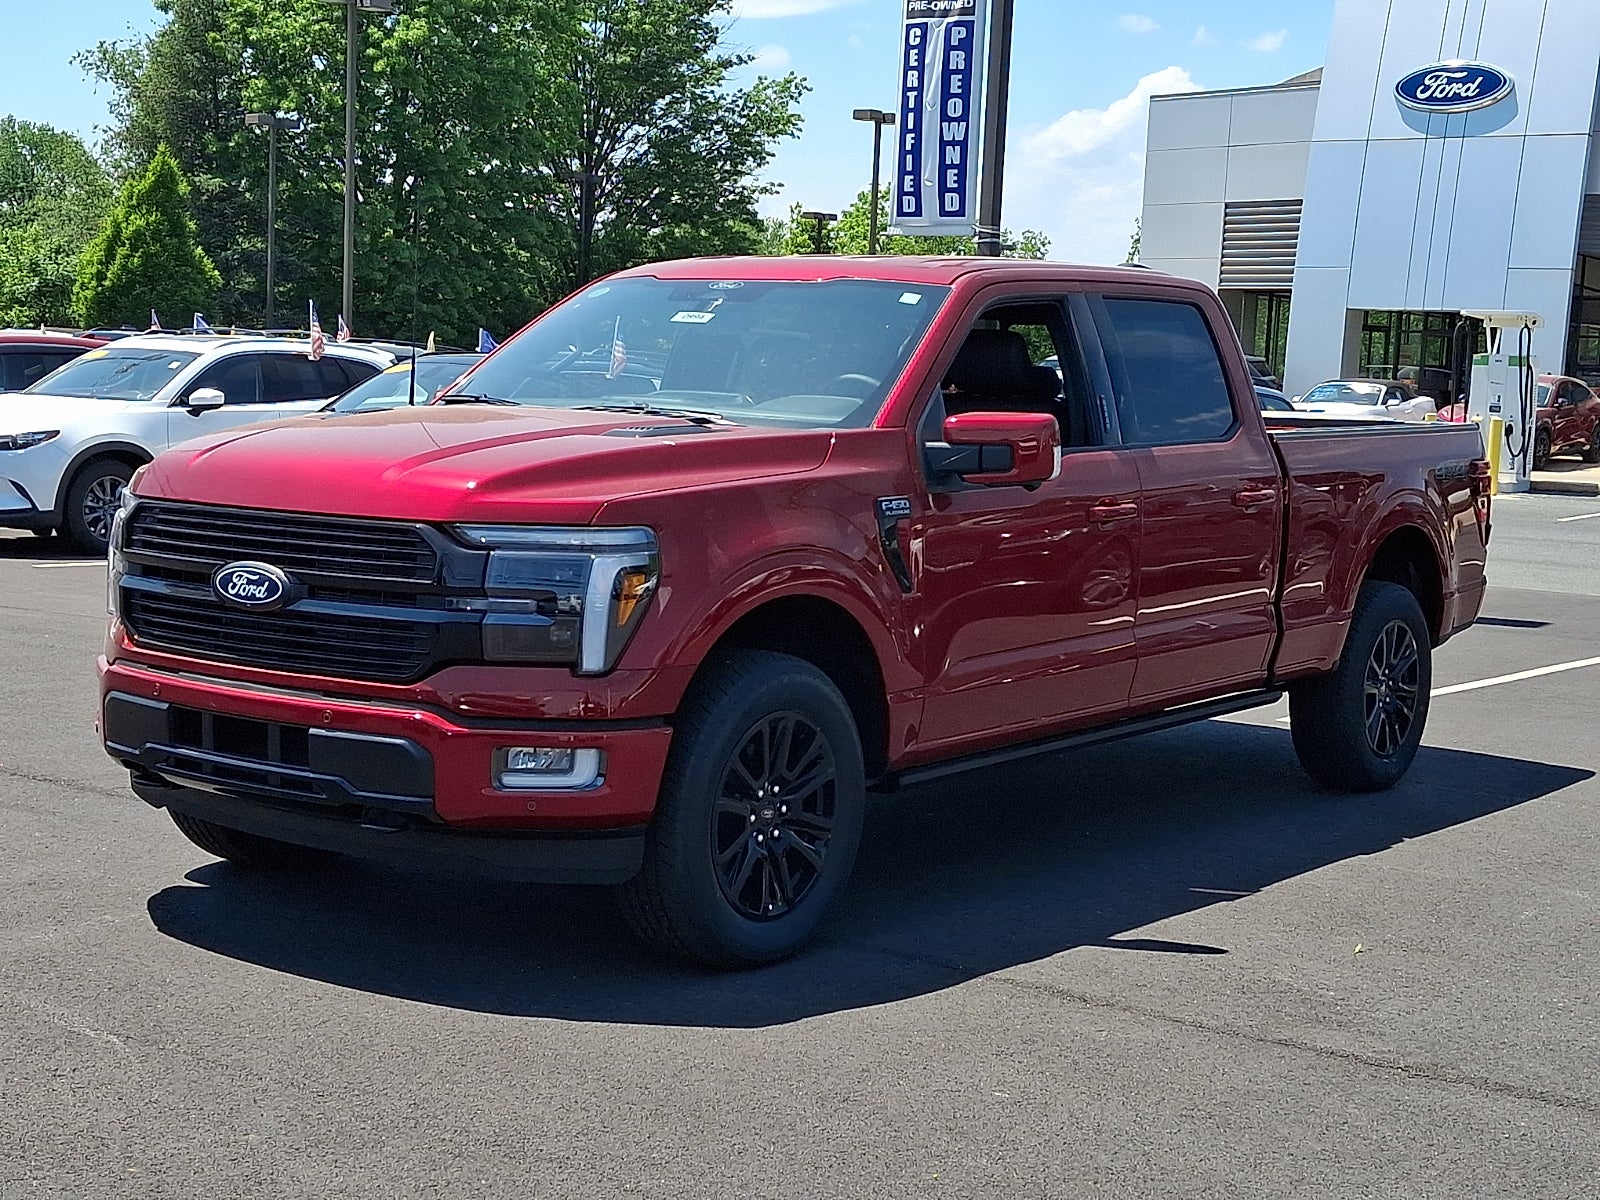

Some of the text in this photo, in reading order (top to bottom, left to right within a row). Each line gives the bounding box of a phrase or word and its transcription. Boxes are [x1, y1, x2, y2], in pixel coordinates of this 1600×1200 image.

[908, 0, 974, 11] PRE-OWNED
[1416, 71, 1484, 99] Ford
[902, 27, 922, 213] CERTIFIED
[941, 26, 967, 212] PREOWNED
[228, 571, 269, 598] Ford
